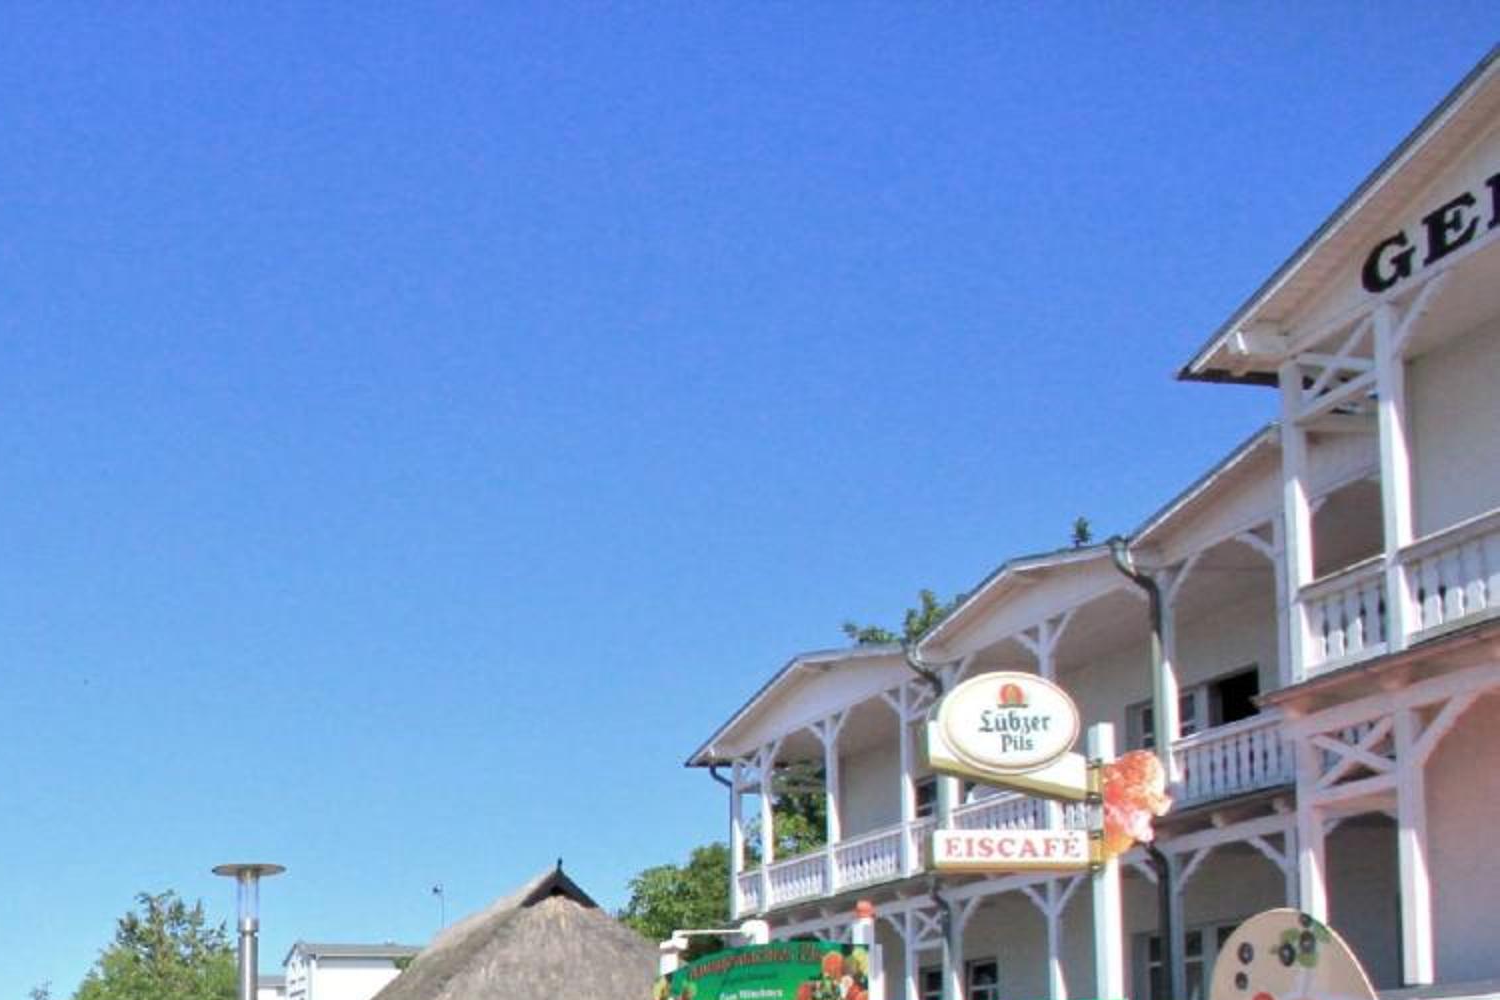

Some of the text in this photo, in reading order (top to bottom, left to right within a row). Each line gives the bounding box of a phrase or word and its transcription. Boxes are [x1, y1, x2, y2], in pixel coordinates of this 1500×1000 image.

[1362, 172, 1500, 293] GE
[978, 709, 1050, 735] Lübzer
[1000, 731, 1034, 752] Pils
[944, 832, 1081, 858] EISCAFÉ
